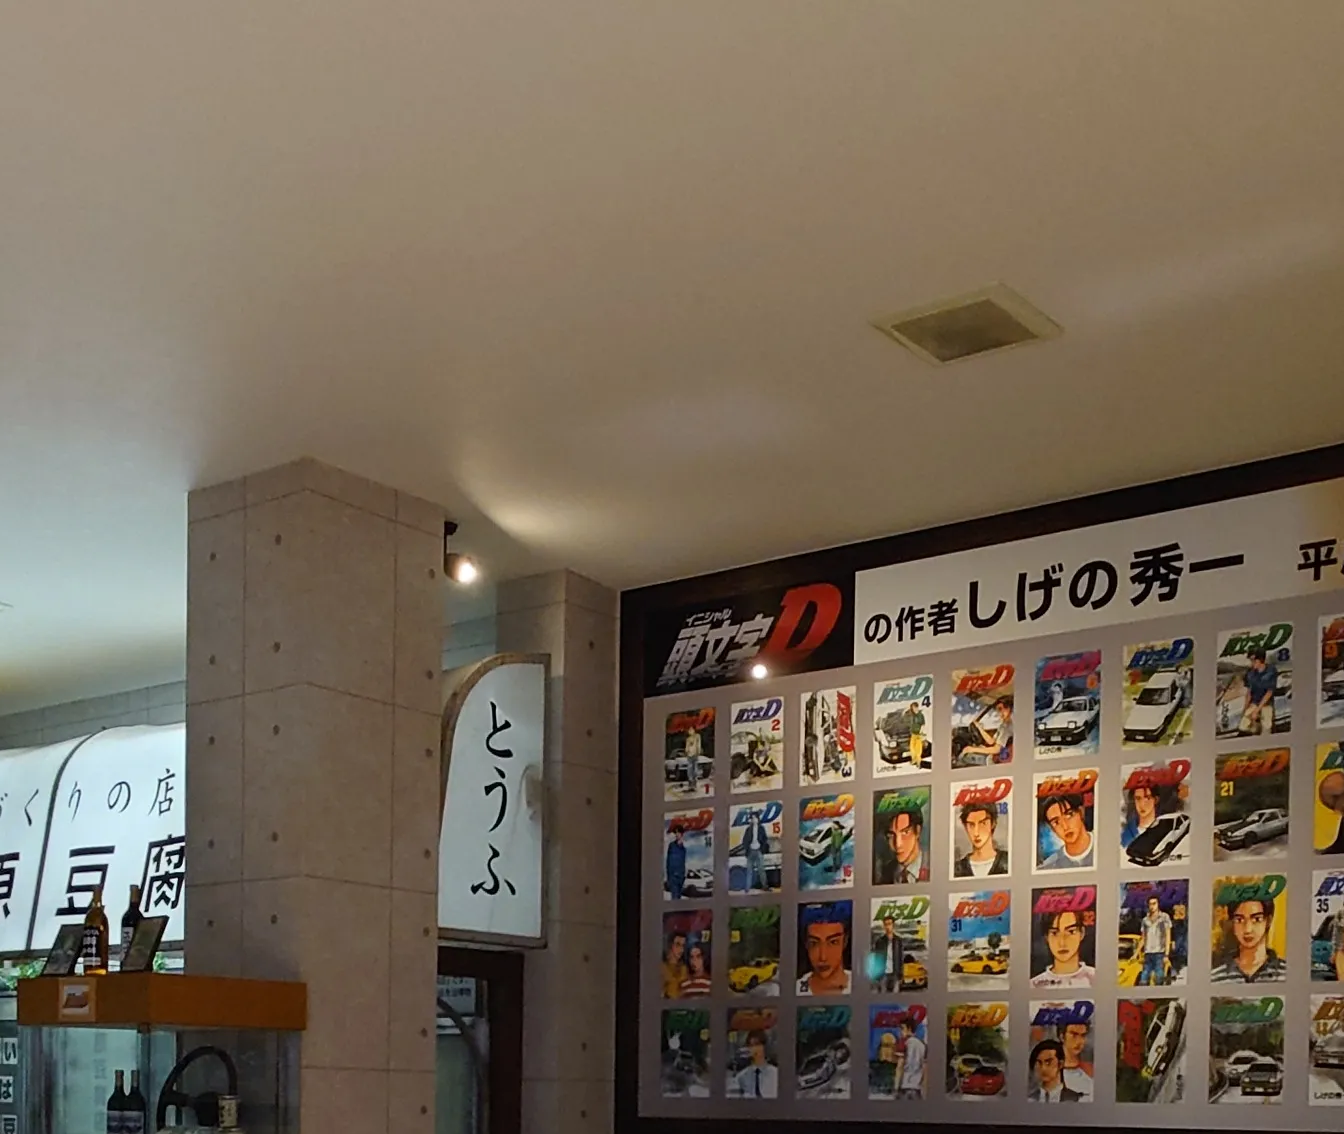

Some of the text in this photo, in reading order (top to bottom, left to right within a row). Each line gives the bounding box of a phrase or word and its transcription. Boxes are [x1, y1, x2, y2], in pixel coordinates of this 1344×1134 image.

[921, 696, 932, 708] 4
[771, 719, 781, 731] 2
[1219, 781, 1234, 797] 21
[469, 700, 517, 897] とうふ
[1315, 899, 1330, 913] 35
